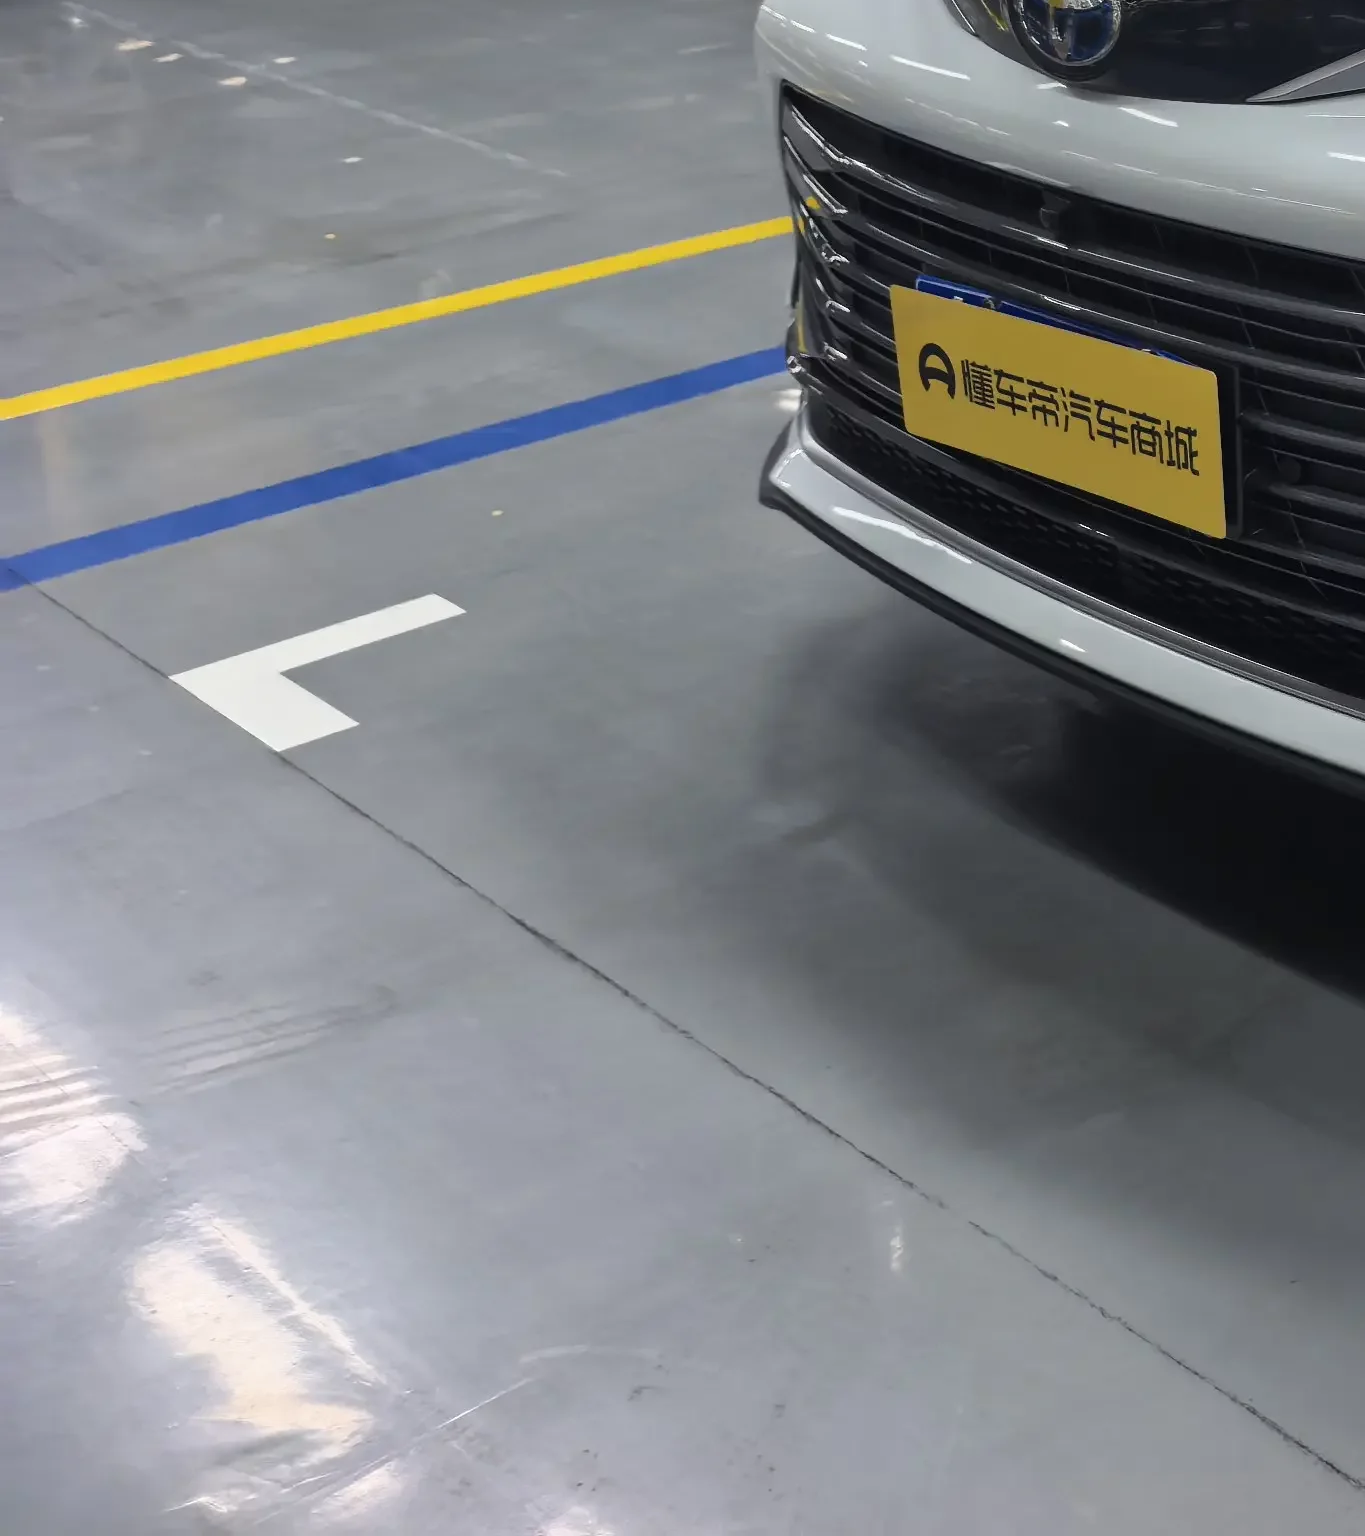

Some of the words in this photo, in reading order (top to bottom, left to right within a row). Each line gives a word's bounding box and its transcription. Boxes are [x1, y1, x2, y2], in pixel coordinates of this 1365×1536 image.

[960, 358, 1200, 477] 懂车帝汽车商城
